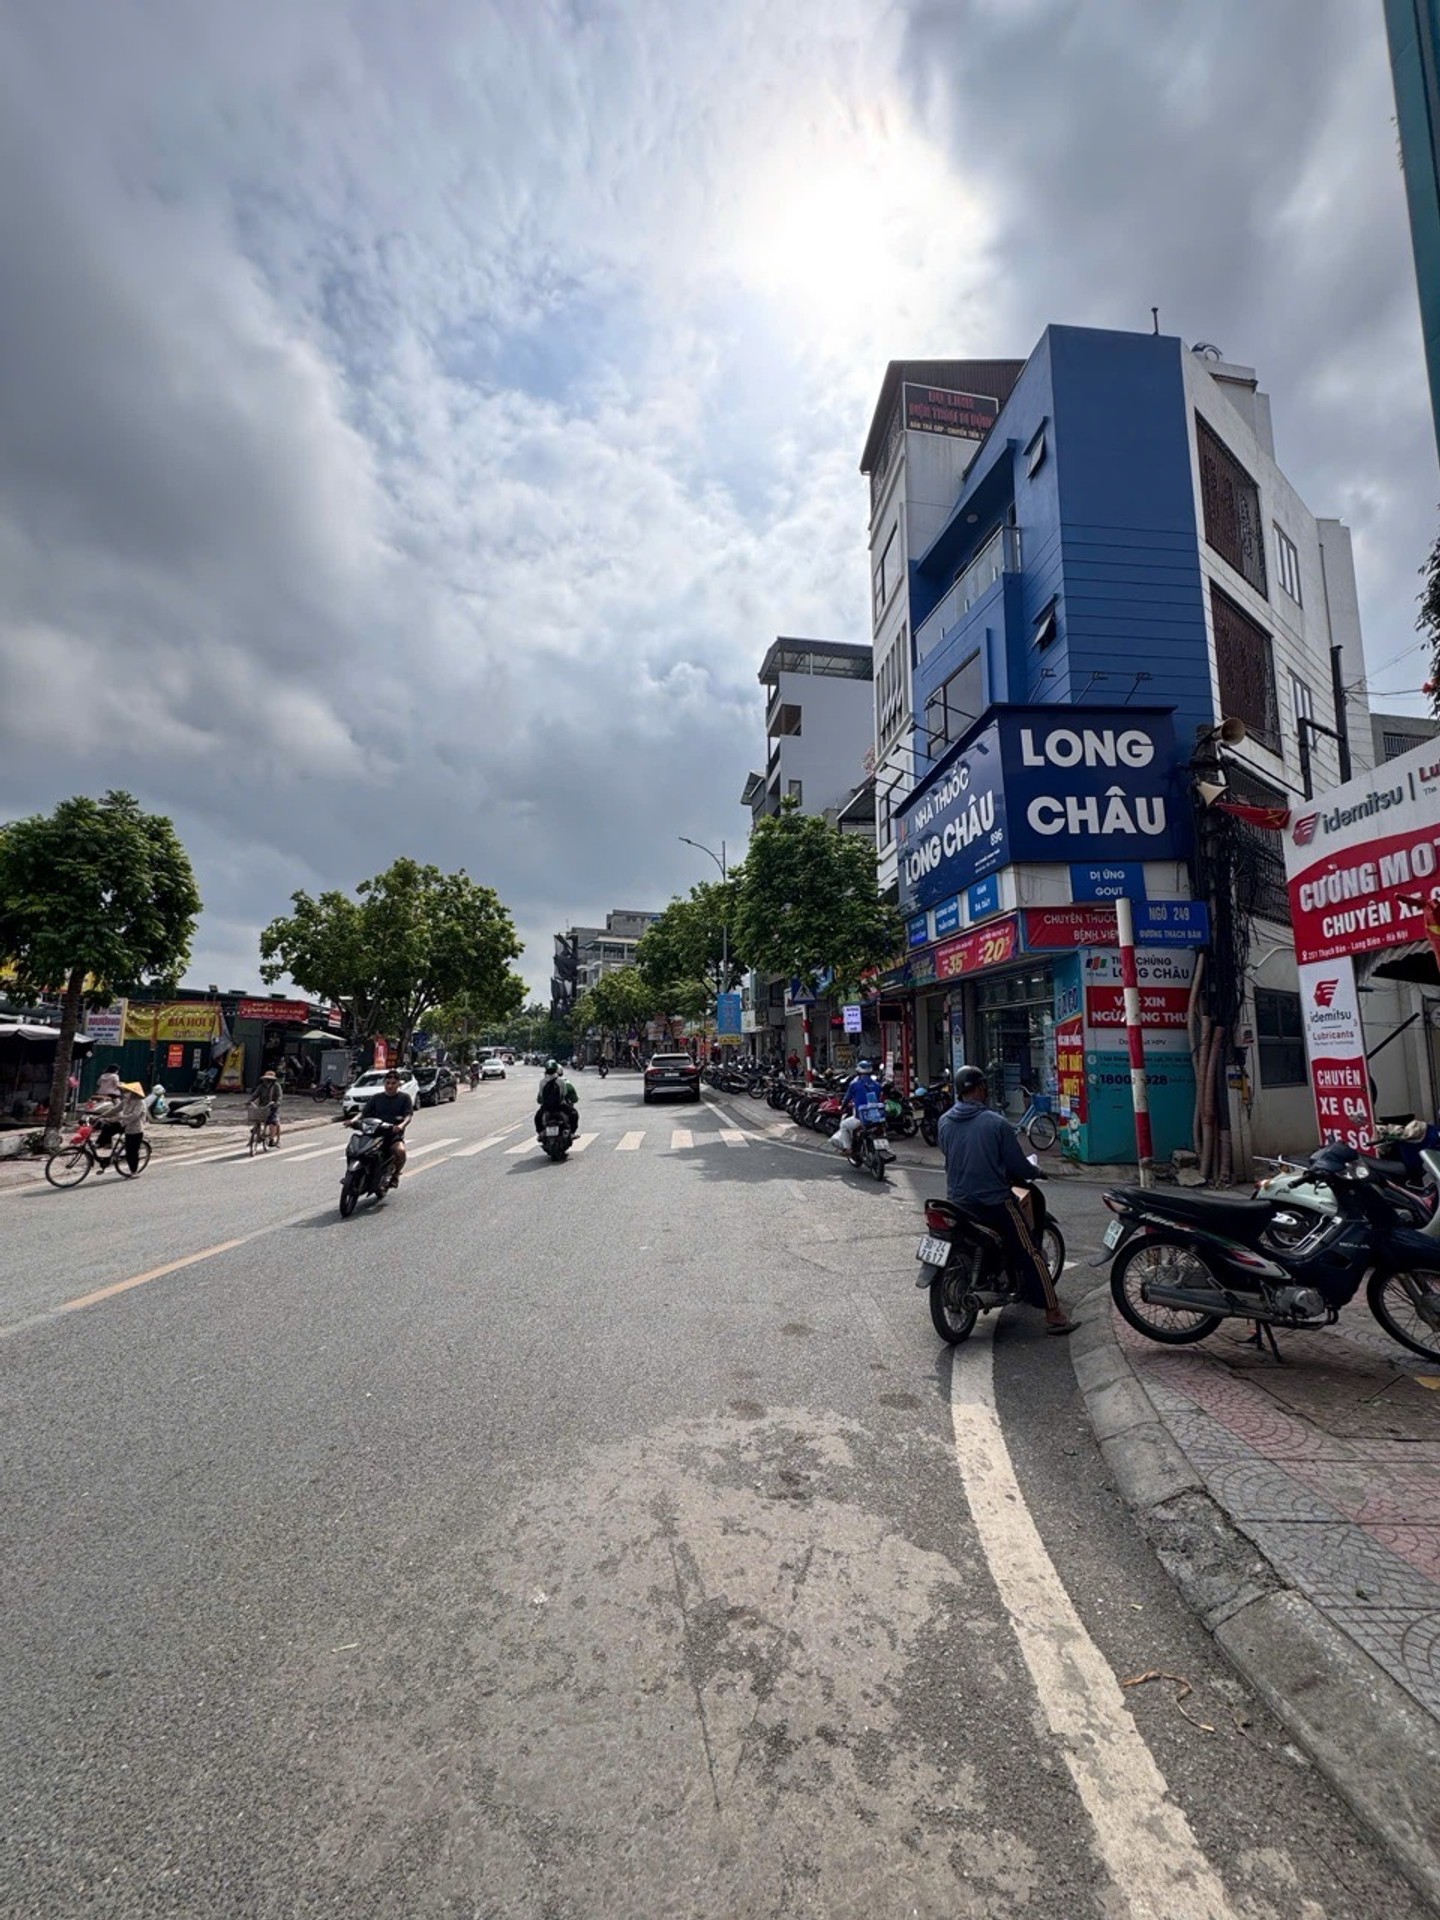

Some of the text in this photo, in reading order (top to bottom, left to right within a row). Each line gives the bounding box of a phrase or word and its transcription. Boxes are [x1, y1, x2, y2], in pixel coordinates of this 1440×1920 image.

[1020, 728, 1154, 767] LONG
[915, 761, 969, 832] NHÀ THUỐC
[1027, 785, 1167, 835] CHÂU
[1322, 786, 1403, 834] idemitsu
[904, 790, 995, 887] LONG CHÂU
[1090, 868, 1125, 882] DỊ ỨNG
[1095, 886, 1124, 896] GOUT
[1300, 863, 1379, 912] CƯỜNG
[1044, 912, 1083, 925] CHUYÊN
[1322, 900, 1391, 938] CHUYÊN
[1074, 928, 1098, 942] BỆNH
[1112, 966, 1190, 979] LG CHÂU
[1144, 997, 1166, 1007] XIN
[1141, 1012, 1162, 1023] NG
[1310, 1008, 1352, 1023] idemitsu
[1312, 1030, 1355, 1041] Lubricants
[1144, 1074, 1168, 1085] 928
[1317, 1065, 1361, 1086] CHUYÊN
[1319, 1097, 1368, 1117] XE GA
[1346, 1124, 1371, 1150] SỐ
